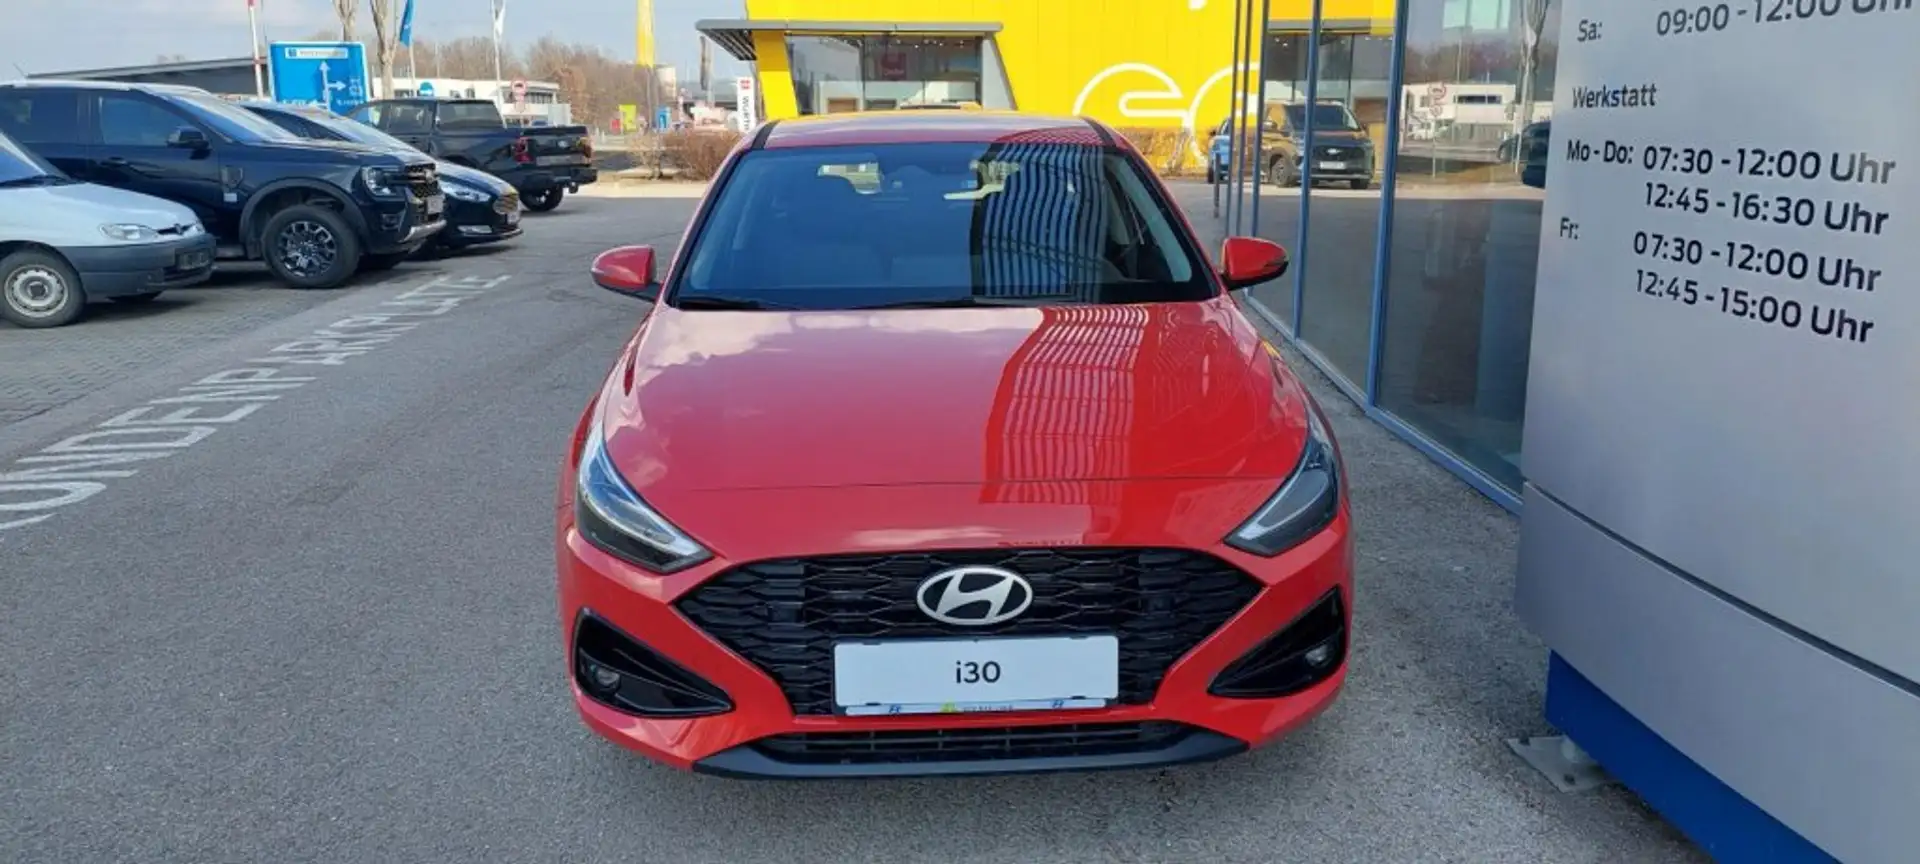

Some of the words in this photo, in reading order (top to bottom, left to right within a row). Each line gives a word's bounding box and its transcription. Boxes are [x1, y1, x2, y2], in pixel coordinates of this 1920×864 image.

[1577, 19, 1602, 42] Sa:
[1657, 3, 1730, 36] 09:00
[1572, 83, 1657, 108] Werkstatt
[1643, 145, 1713, 175] 07:30
[1830, 152, 1896, 184] Uhr
[1646, 182, 1709, 214] 12:45
[1824, 200, 1889, 235] Uhr
[1560, 217, 1579, 240] Fr:
[1633, 231, 1704, 265] 07:30
[1817, 256, 1882, 292] Uhr
[1637, 269, 1699, 305] 12:45
[1810, 305, 1874, 343] Uhr
[956, 660, 1001, 684] i30
